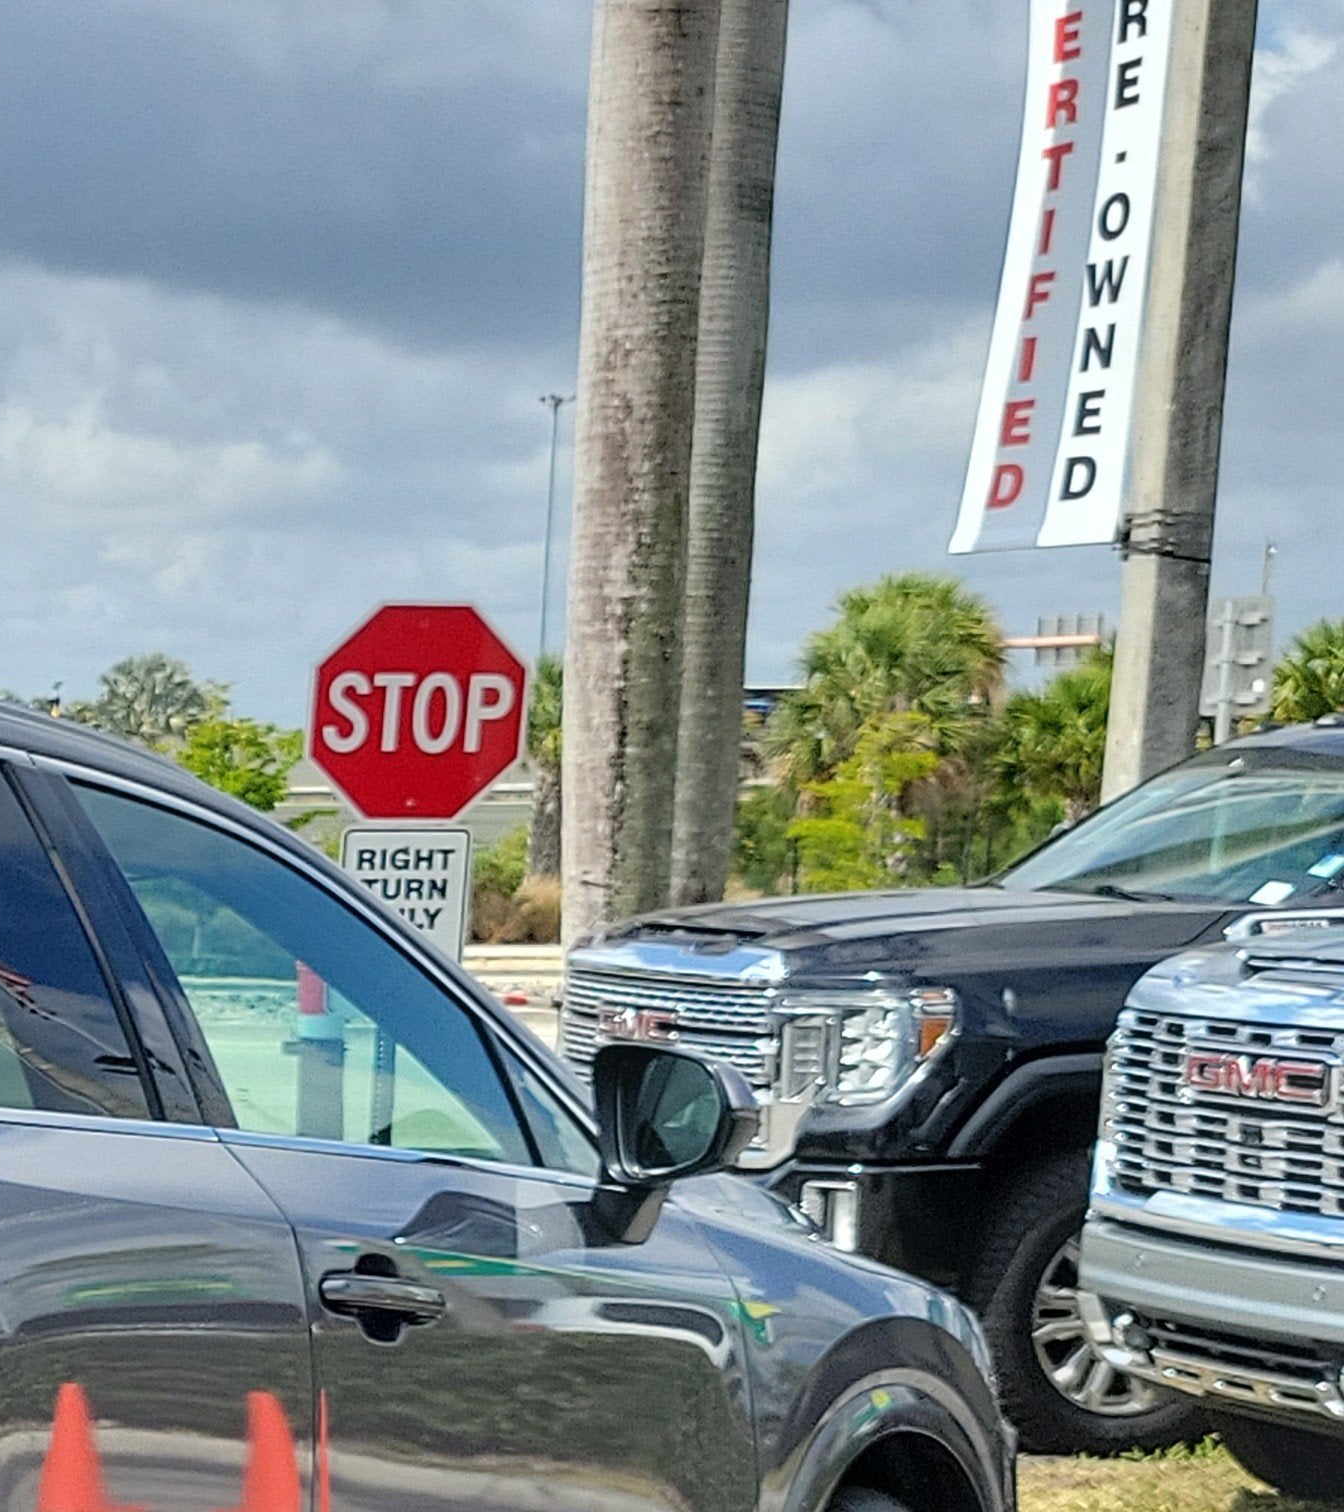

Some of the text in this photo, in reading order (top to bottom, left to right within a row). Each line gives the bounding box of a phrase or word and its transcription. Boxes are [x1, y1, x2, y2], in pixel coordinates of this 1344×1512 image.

[985, 10, 1082, 511] ERTIFIED
[322, 671, 516, 755] STOP
[357, 847, 456, 871] RIGHT
[1186, 1053, 1329, 1104] GMC
